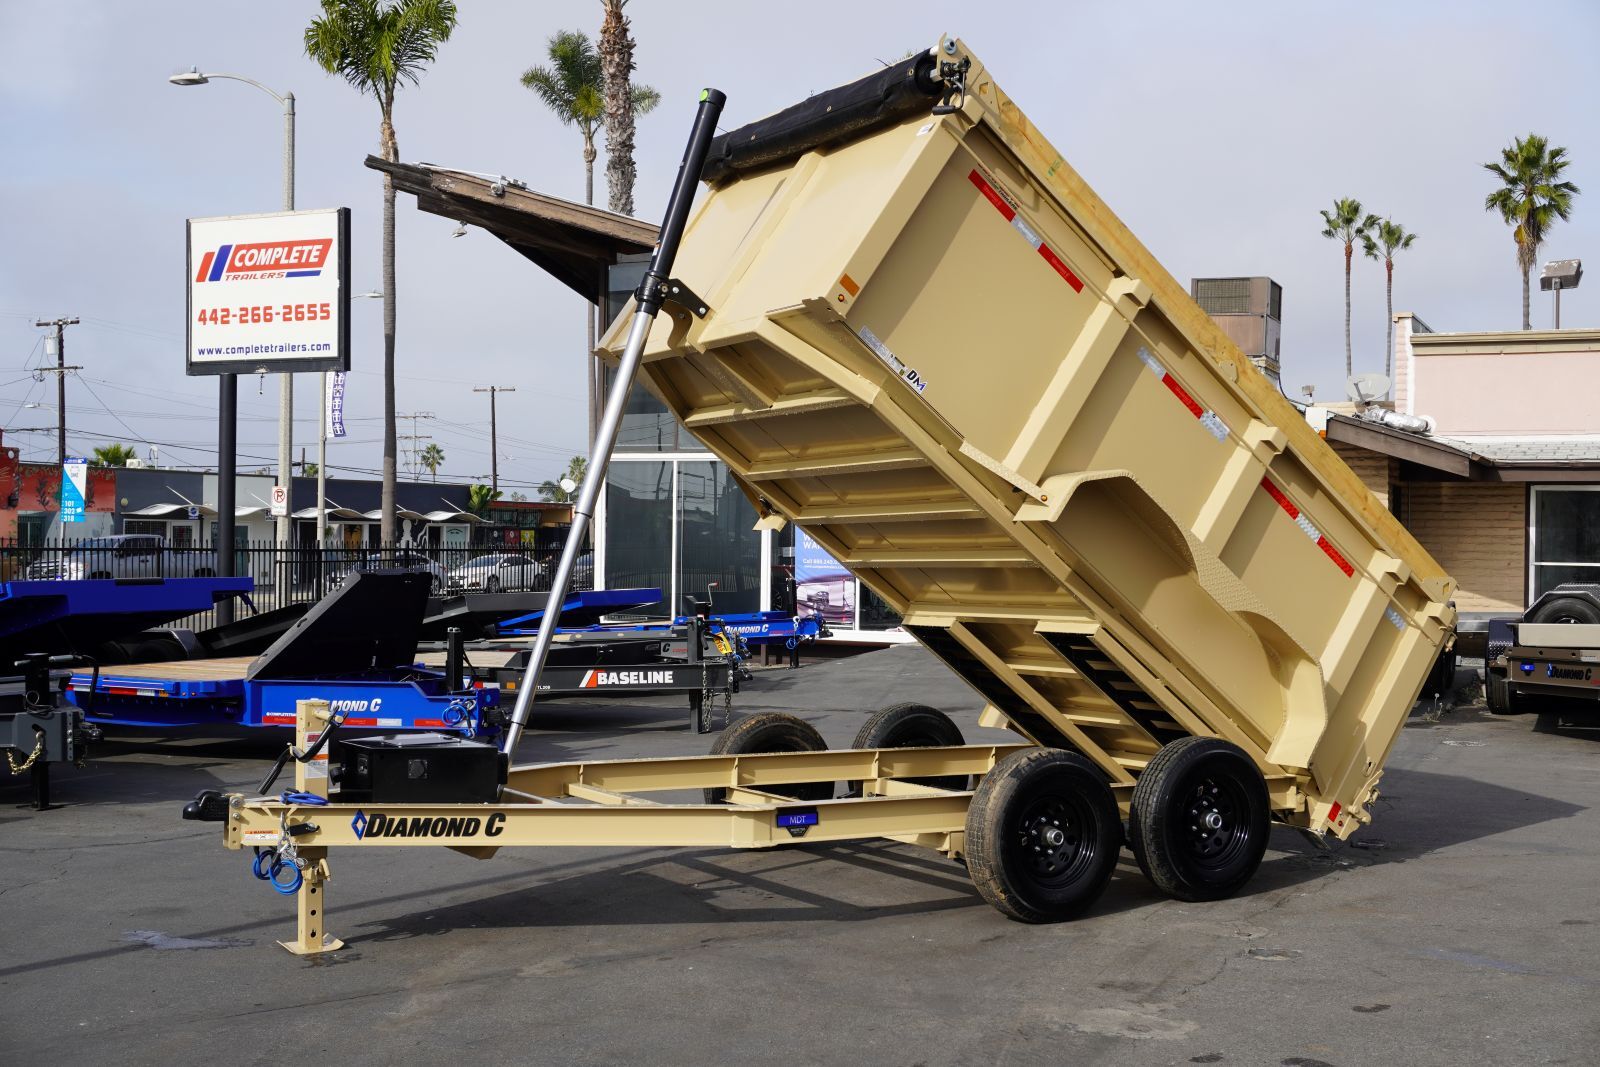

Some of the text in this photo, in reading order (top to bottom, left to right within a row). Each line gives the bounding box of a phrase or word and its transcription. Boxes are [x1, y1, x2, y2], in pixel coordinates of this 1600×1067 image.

[234, 244, 323, 267] COMPLETE
[225, 271, 286, 282] TRAILERS
[197, 303, 331, 326] 442-266-2655
[198, 343, 331, 356] www.completetrailers.com
[725, 625, 761, 634] DIAMOND
[761, 623, 769, 633] C
[597, 670, 674, 685] BASELINE
[1552, 666, 1592, 680] DIAMOND C
[330, 698, 382, 712] MOND C
[364, 812, 506, 838] DIAMOND C
[789, 815, 807, 825] MDT
